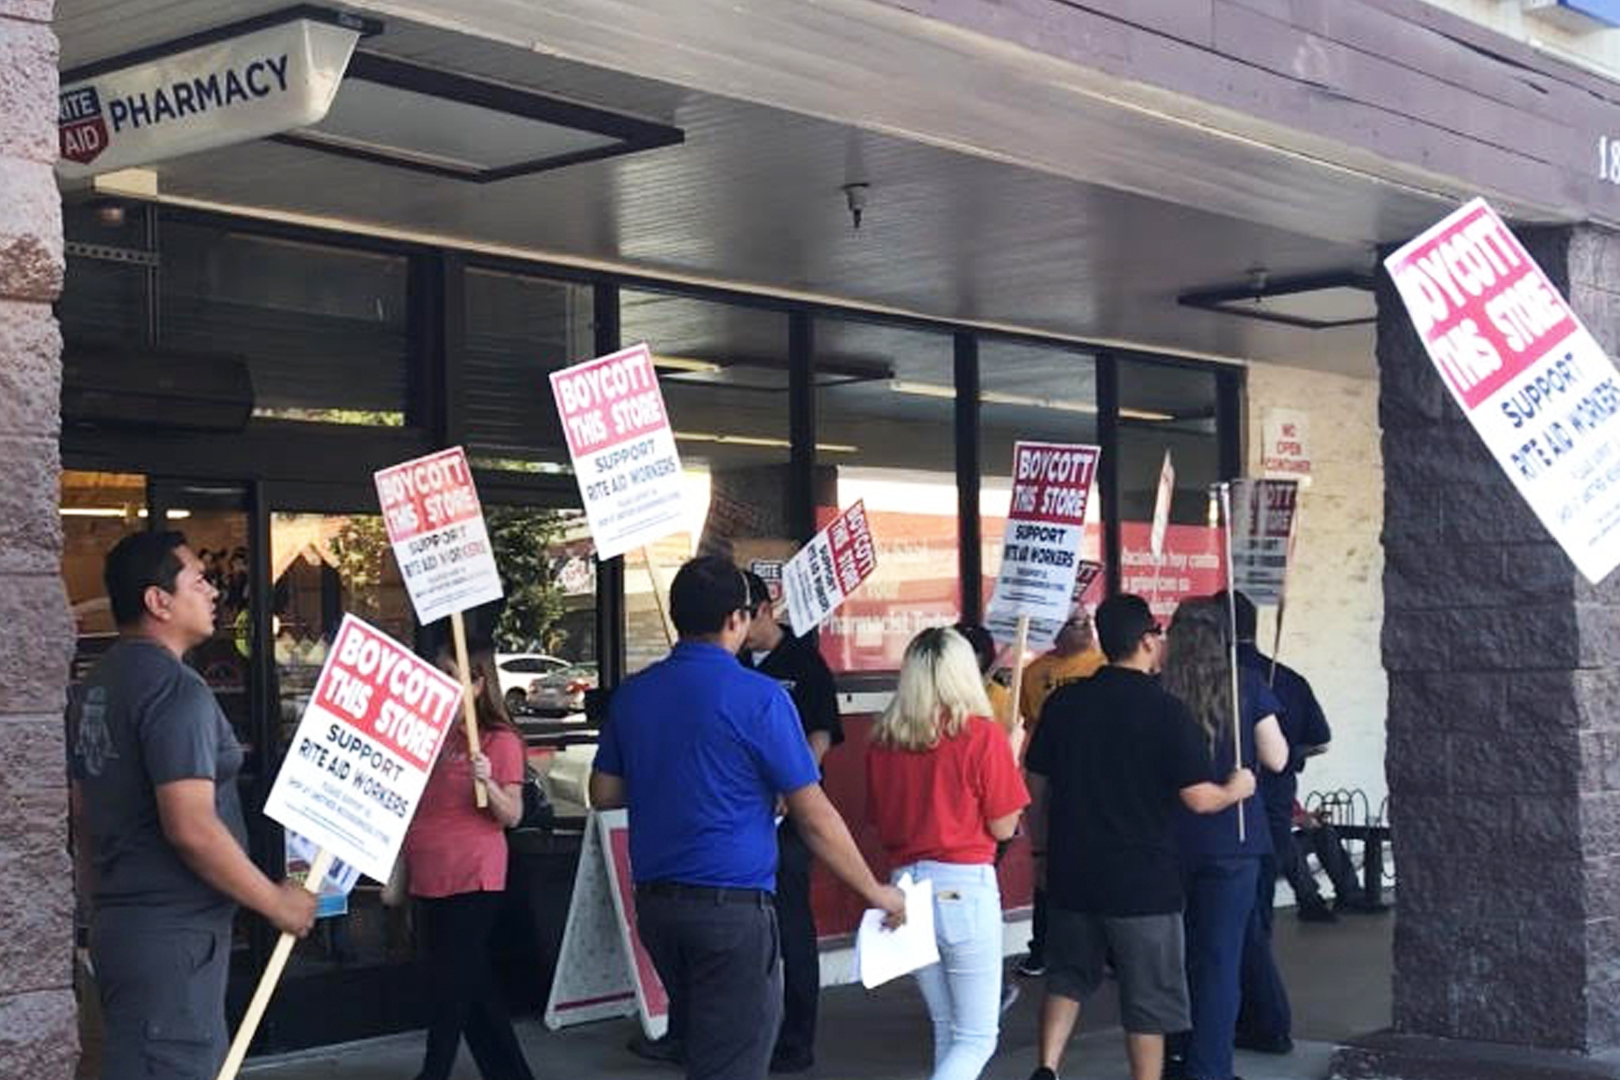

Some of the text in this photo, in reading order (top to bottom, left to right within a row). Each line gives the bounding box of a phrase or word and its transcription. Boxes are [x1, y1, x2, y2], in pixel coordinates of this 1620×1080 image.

[108, 54, 288, 132] PHARMACY
[65, 126, 100, 155] AID
[1485, 271, 1567, 353] STORE
[558, 354, 650, 414] BOYCOTT
[1501, 352, 1584, 428] SUPPORT
[567, 390, 662, 448] THIS STORE
[1542, 421, 1574, 460] AID
[586, 480, 611, 501] RITE
[611, 473, 628, 493] AID
[629, 455, 677, 485] WORKERS
[594, 438, 655, 473] SUPPORT
[1018, 449, 1094, 484] BOYCOTT
[1013, 484, 1087, 518] THIS STORE
[1015, 525, 1067, 545] SUPPORT
[1031, 546, 1075, 568] WORKERS
[339, 626, 455, 722] BOYCOTT
[324, 667, 441, 763] THIS STORE
[299, 737, 330, 769] RITE
[327, 755, 351, 780] AID
[352, 767, 410, 819] WORKERS
[325, 723, 405, 782] SUPPORT
